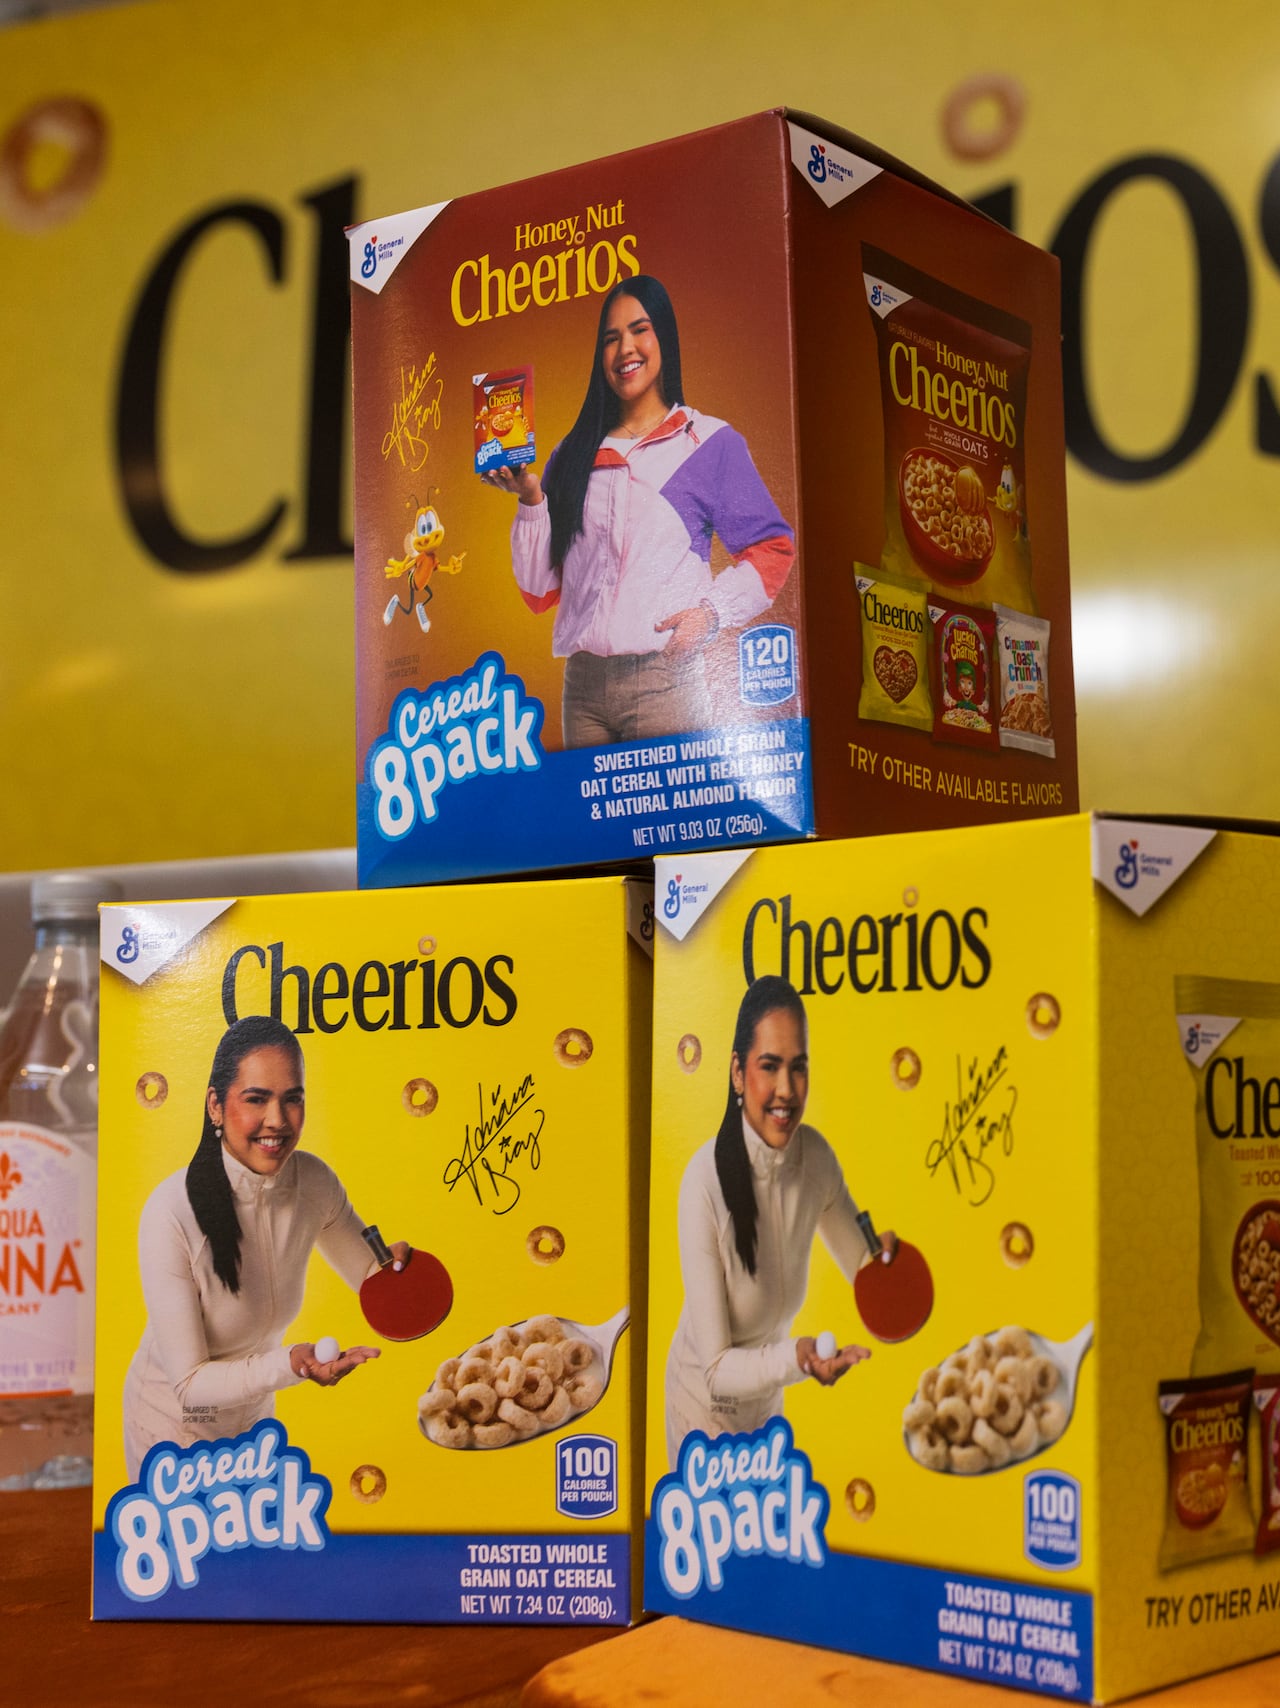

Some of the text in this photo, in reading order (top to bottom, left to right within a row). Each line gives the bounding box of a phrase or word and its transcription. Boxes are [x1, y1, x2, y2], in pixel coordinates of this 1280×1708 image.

[828, 159, 853, 178] General
[515, 199, 625, 251] Honey Nut
[378, 236, 403, 252] General
[378, 250, 393, 261] Mills
[450, 231, 640, 328] Cheerios
[936, 341, 1008, 392] Honey Nut
[889, 342, 1016, 448] Cheerios
[961, 438, 989, 459] OATS
[864, 593, 923, 633] Cheerios
[744, 635, 789, 668] 120
[950, 643, 978, 666] Charms
[953, 629, 976, 650] Lucky
[1004, 636, 1040, 651] Cinnamon
[746, 666, 786, 680] CALORIES
[1008, 662, 1041, 682] Crunch
[1012, 651, 1034, 666] Toast
[744, 677, 792, 692] PER POUCH
[398, 665, 498, 744] Cereal
[594, 730, 786, 773] SWEETENED WHOLE GRAIN
[580, 752, 804, 799] OAT CEREAL WITH REAL HONEY
[848, 743, 1063, 805] TRY OTHER AVAILABLE FLAVORS
[590, 778, 797, 821] & NATURAL ALMOND FLAVOR
[633, 828, 655, 847] NET
[657, 826, 676, 844] WT
[679, 822, 704, 842] 9.03
[706, 820, 722, 838] OZ
[683, 883, 709, 894] General
[742, 886, 992, 996] Cheerios
[222, 935, 518, 1034] Cheerios
[1171, 1416, 1244, 1453] Cheerios
[152, 1433, 277, 1505] Cereal
[561, 1446, 611, 1478] 100
[687, 1431, 786, 1500] Cereal
[561, 1491, 613, 1503] PER POUCH
[564, 1479, 607, 1491] CALORIES
[1030, 1482, 1075, 1523] 100
[468, 1544, 607, 1564] TOASTED WHOLE
[460, 1569, 616, 1588] GRAIN OAT CEREAL
[460, 1595, 485, 1615] NET
[488, 1595, 511, 1615] WT
[515, 1595, 543, 1615] 7.34
[546, 1595, 564, 1615] OZ
[944, 1581, 1072, 1627] TOASTED WHOLE
[1145, 1597, 1184, 1628] TRY
[1189, 1588, 1252, 1623] OTHER
[939, 1608, 1080, 1657] GRAIN OAT CEREAL
[939, 1639, 961, 1664] NET
[963, 1644, 985, 1667] WT
[987, 1648, 1013, 1675] 7.34
[1016, 1653, 1032, 1678] OZ
